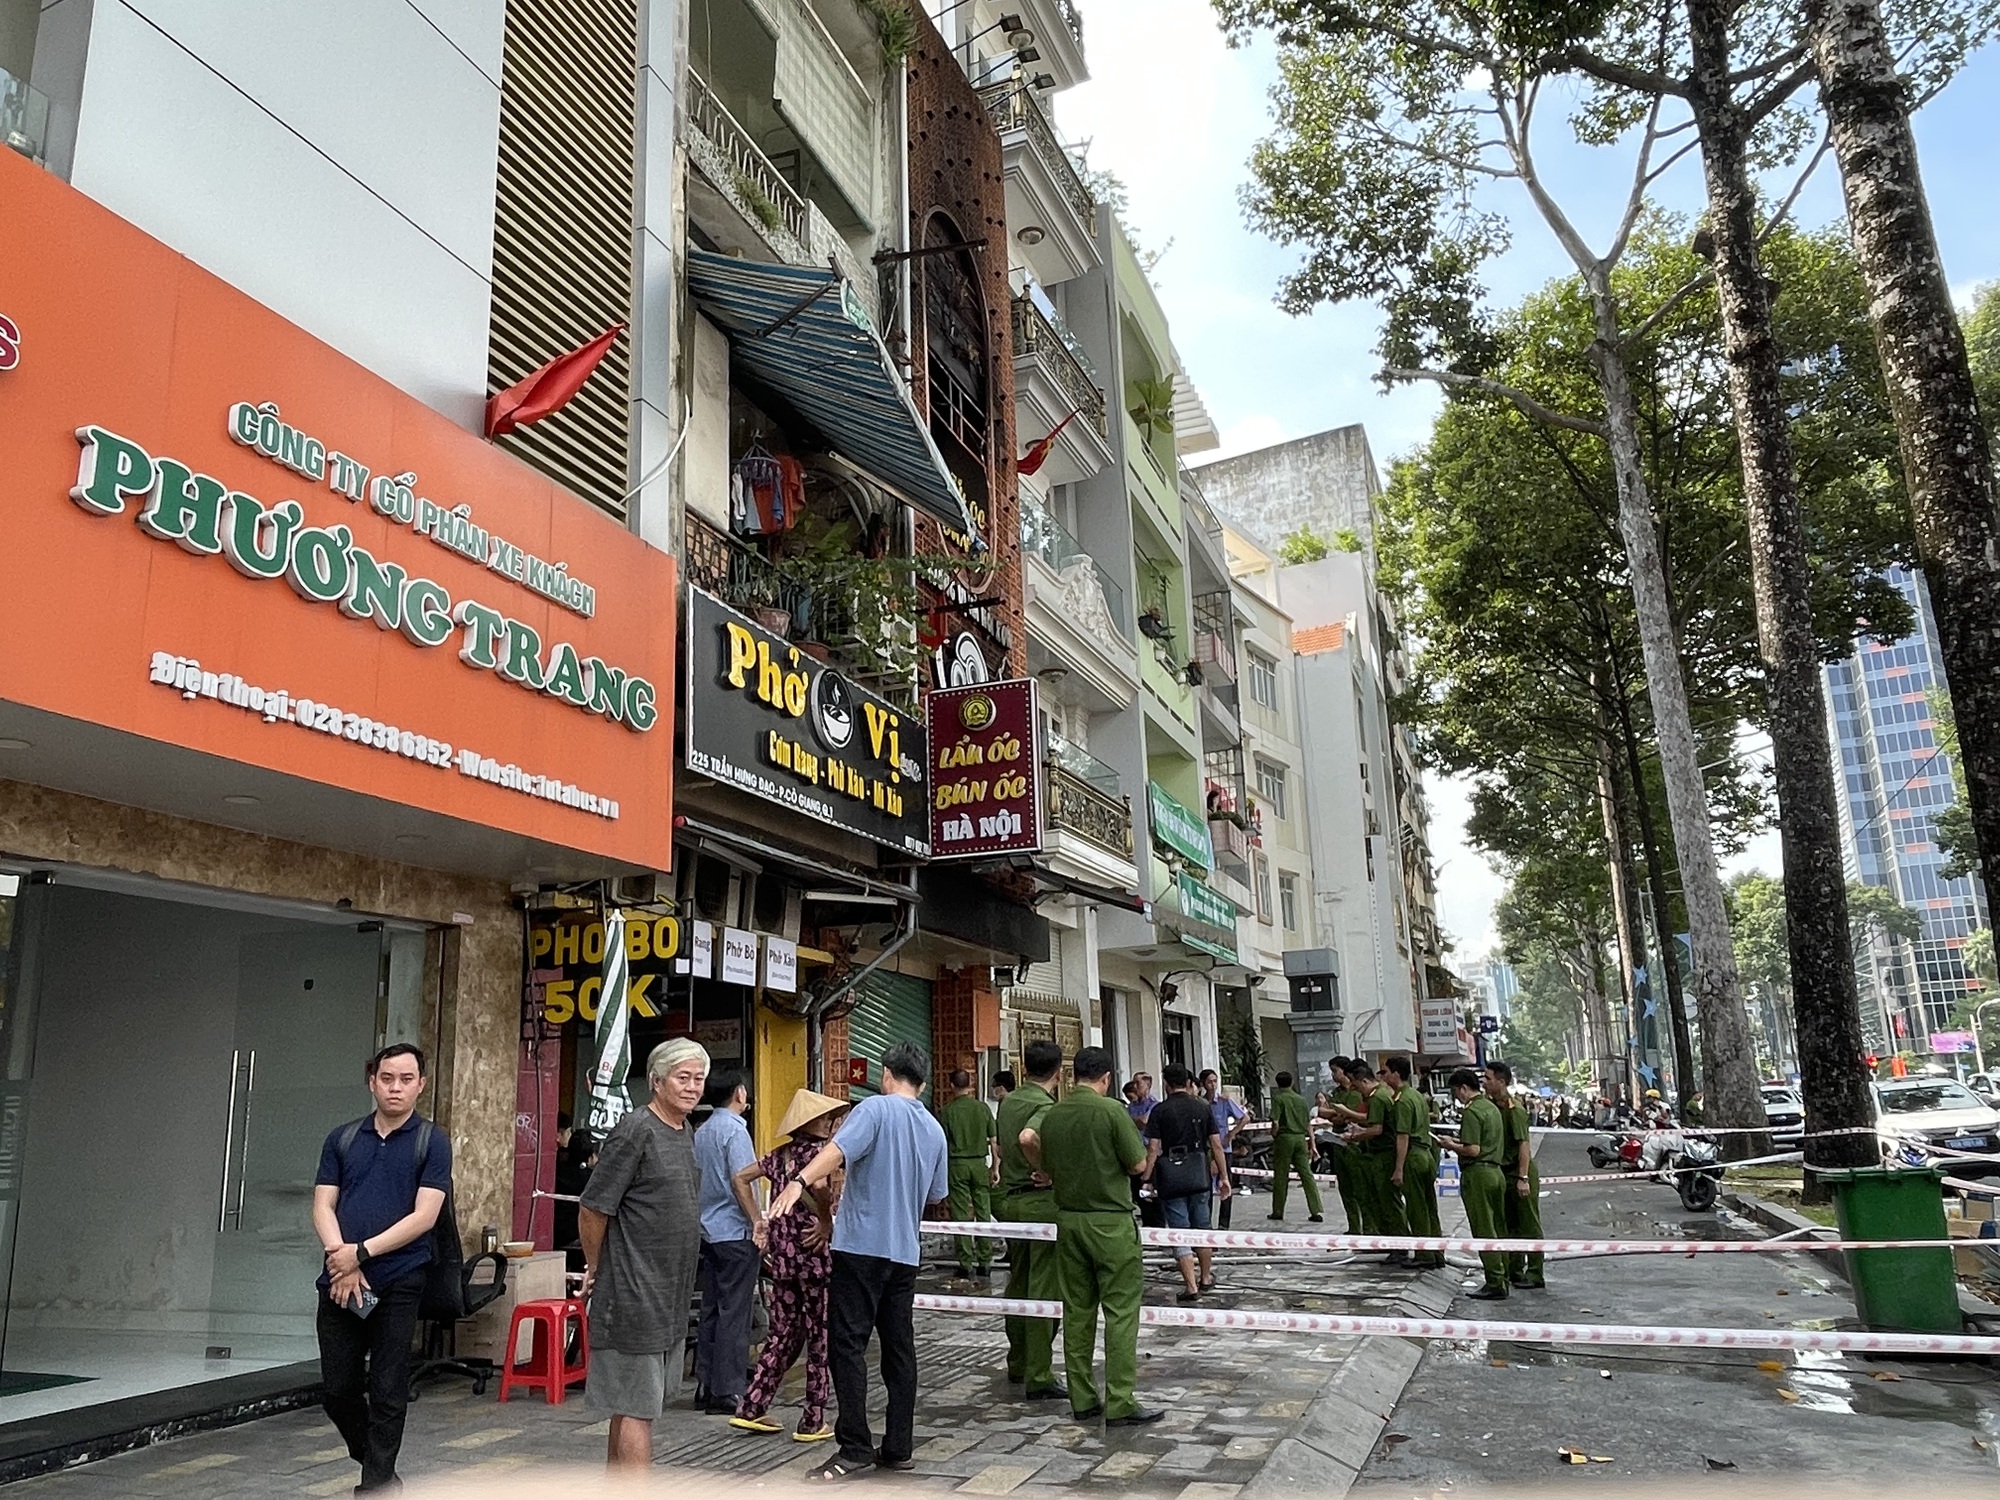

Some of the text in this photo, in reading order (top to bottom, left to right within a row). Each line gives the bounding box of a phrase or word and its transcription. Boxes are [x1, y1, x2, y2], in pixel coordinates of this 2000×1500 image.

[228, 401, 595, 618] CÔNG TY CỔ PHẦN XE KHÁCH
[69, 424, 658, 732] PHƯƠNG TRANG
[727, 621, 900, 783] Phở Vị
[793, 741, 818, 785] Rang
[827, 757, 844, 792] Phở
[987, 731, 1020, 763] ỐC
[691, 750, 709, 769] 225
[710, 755, 733, 777] TRẦN
[734, 768, 757, 788] HƯNG
[936, 769, 1027, 810] BÚN ỐC
[942, 809, 1022, 842] HÀ NỘI
[726, 940, 756, 960] Phở Bò
